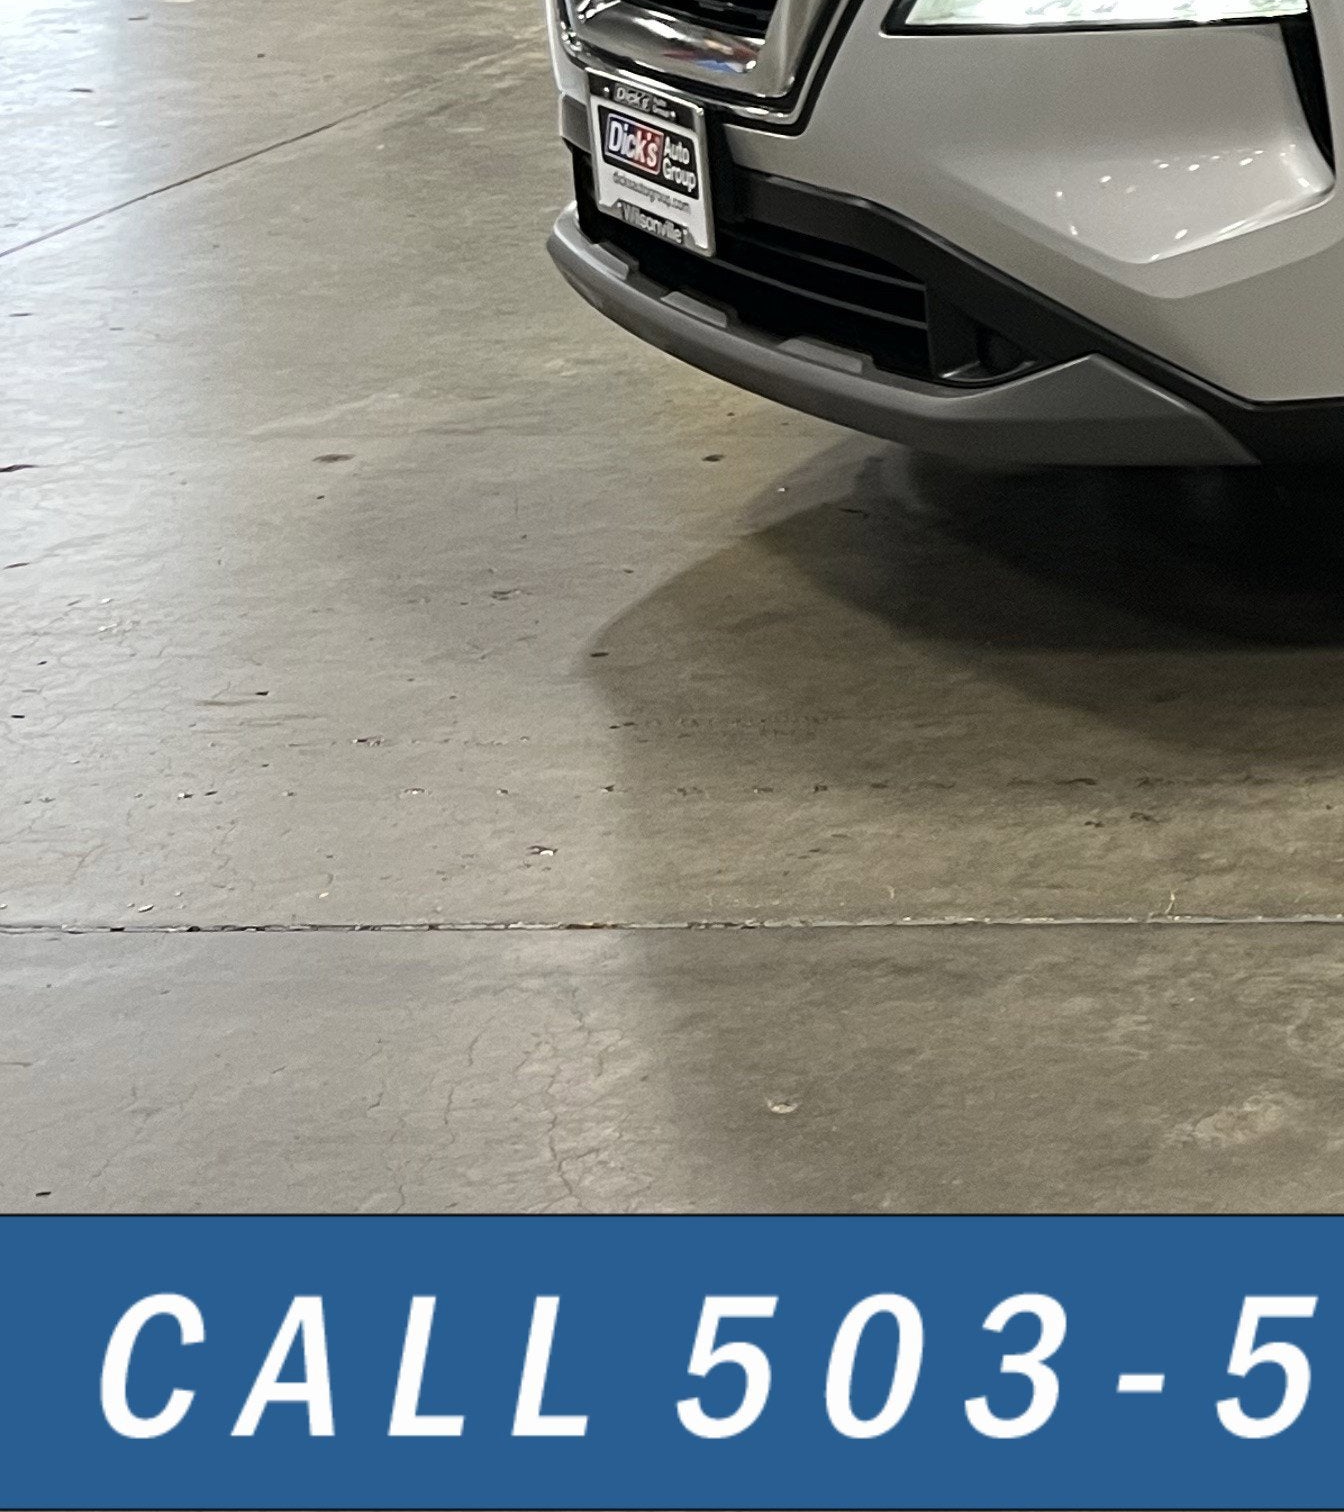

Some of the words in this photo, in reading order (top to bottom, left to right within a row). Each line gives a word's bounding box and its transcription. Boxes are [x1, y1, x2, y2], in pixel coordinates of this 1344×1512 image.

[608, 120, 659, 168] Dick's
[664, 136, 691, 165] Auto
[662, 157, 697, 193] Group
